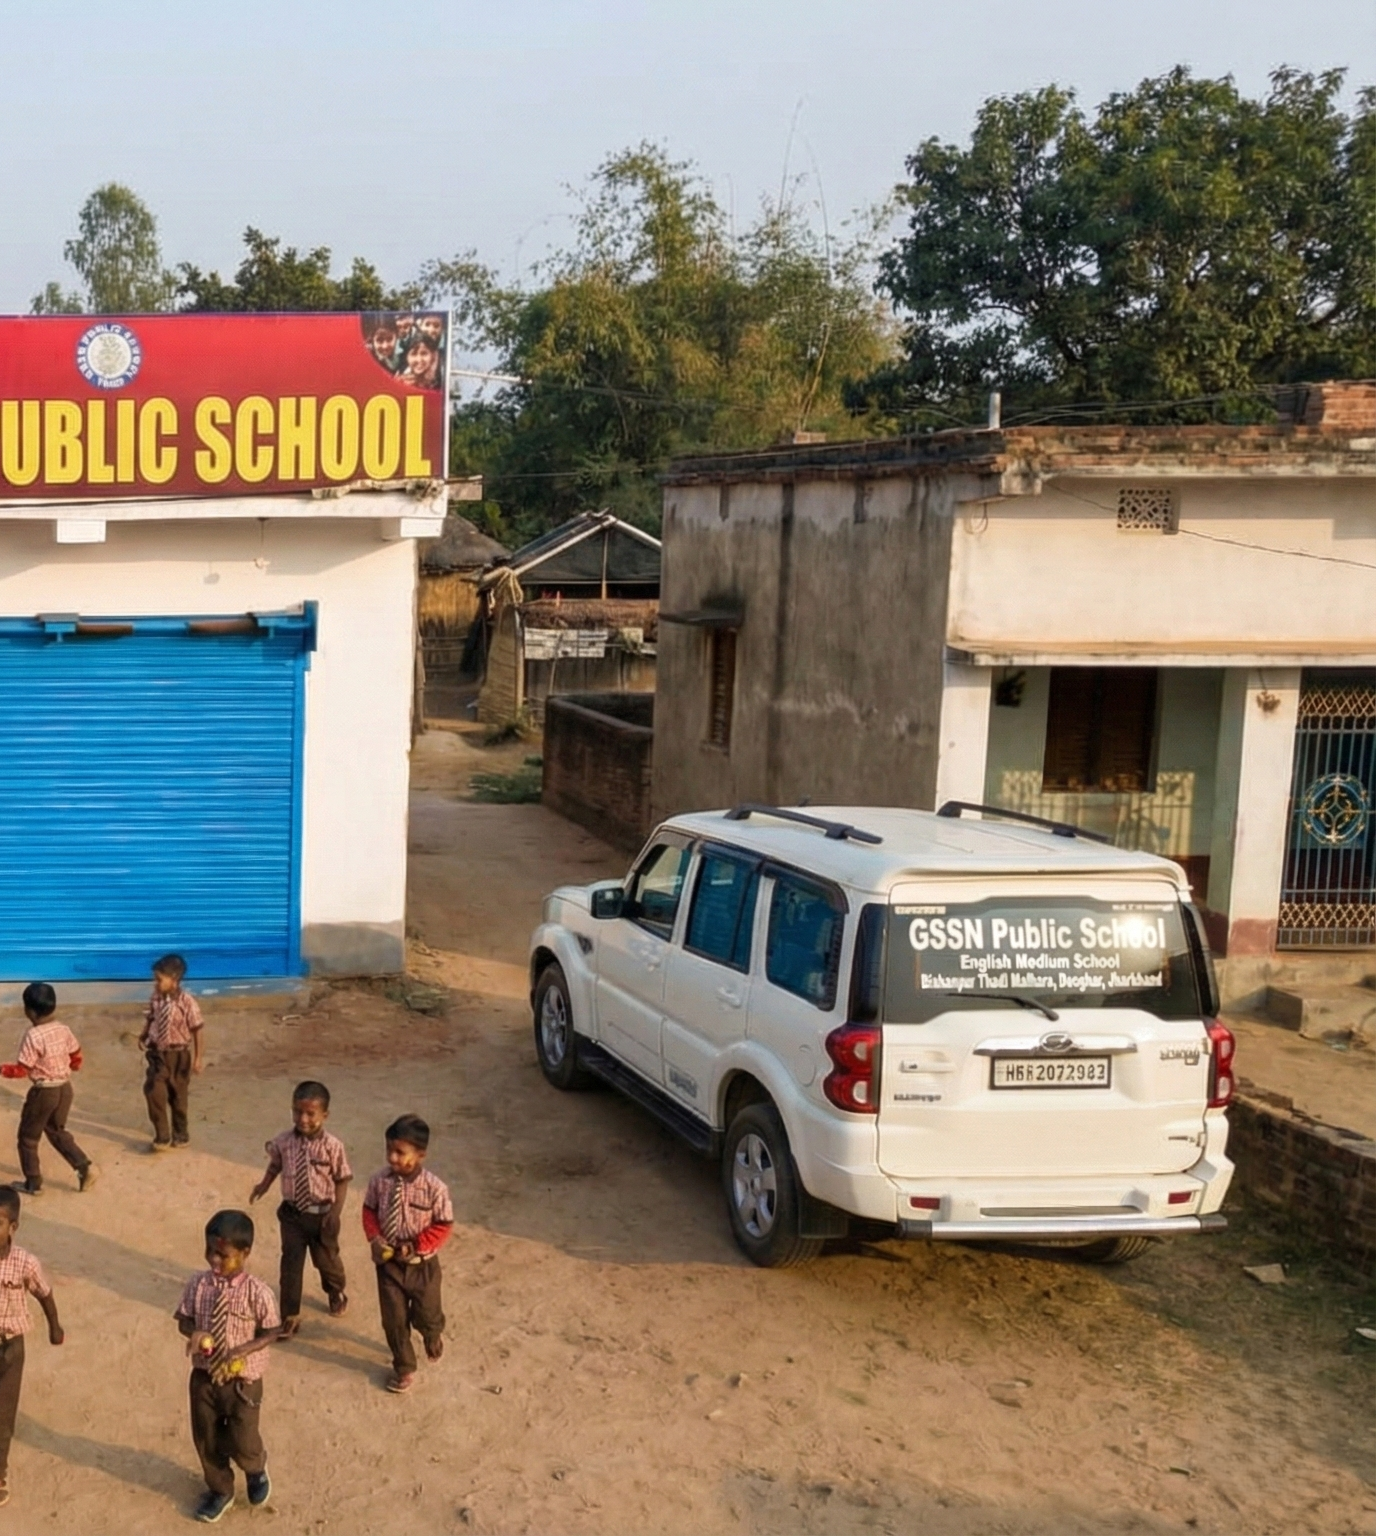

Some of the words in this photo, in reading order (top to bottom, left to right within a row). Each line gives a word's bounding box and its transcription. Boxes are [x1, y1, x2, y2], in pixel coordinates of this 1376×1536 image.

[193, 394, 432, 484] SCHOOL
[909, 918, 984, 950] GSSN
[991, 917, 1073, 949] Public
[1080, 917, 1166, 949] School
[960, 953, 1012, 973] English
[1015, 953, 1070, 969] Medium
[1073, 952, 1120, 968] School
